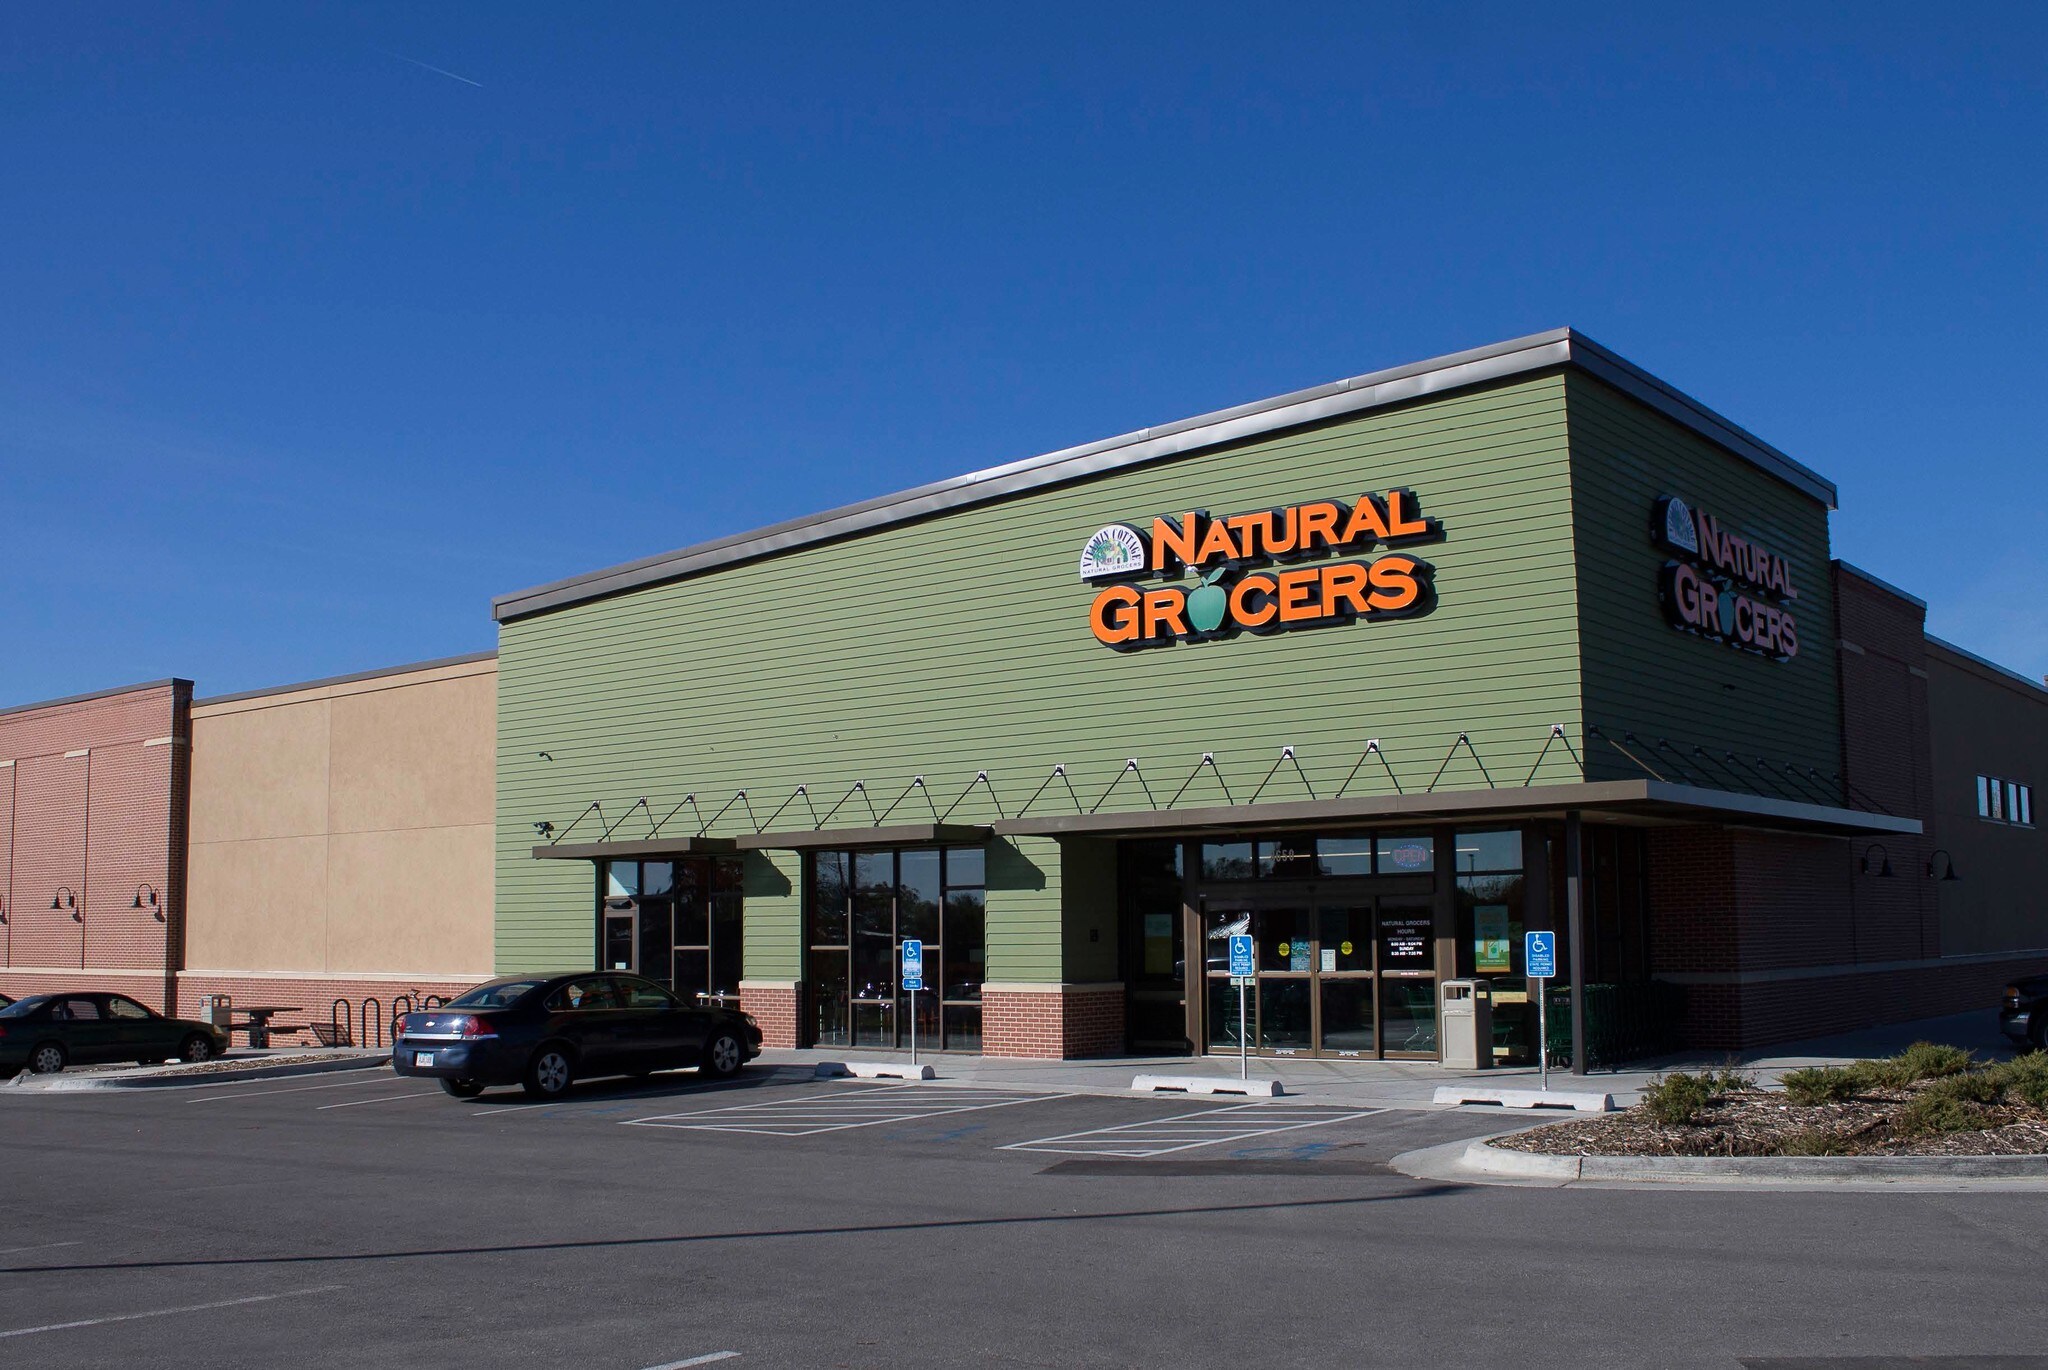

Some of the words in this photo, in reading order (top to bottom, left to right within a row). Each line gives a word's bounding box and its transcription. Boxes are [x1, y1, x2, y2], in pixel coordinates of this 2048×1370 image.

[1083, 530, 1110, 567] VITAMIN
[1112, 529, 1141, 560] COTTAGE
[1152, 490, 1427, 571] NATURAL
[1083, 567, 1110, 575] NATURAL
[1112, 562, 1141, 570] GROCERS
[1697, 508, 1798, 599] NATURAL
[1393, 848, 1426, 863] OPEN
